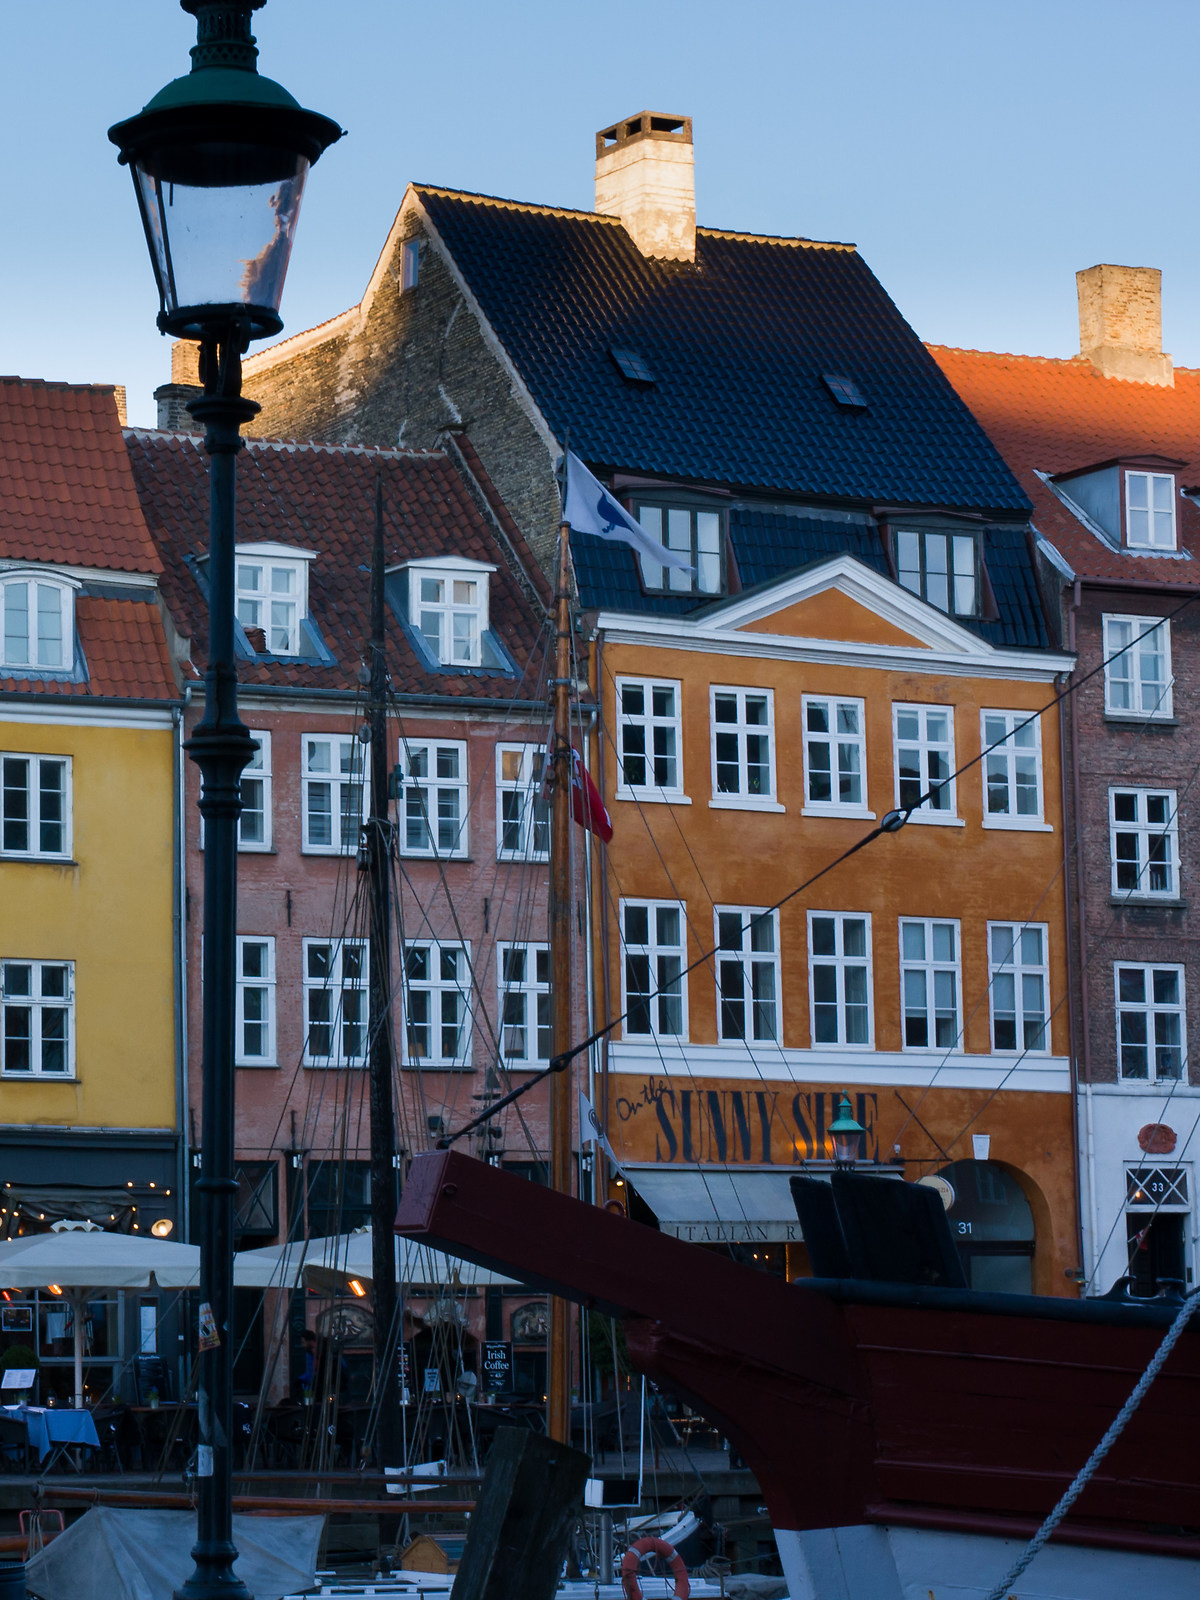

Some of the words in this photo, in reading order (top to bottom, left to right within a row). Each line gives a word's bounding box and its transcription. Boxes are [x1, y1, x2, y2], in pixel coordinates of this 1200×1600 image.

[616, 1098, 643, 1121] On
[640, 1075, 668, 1104] the
[656, 1090, 779, 1164] SUNNY
[1152, 1182, 1164, 1192] 33
[675, 1225, 768, 1241] ITALIAN
[958, 1222, 972, 1234] 31
[487, 1350, 506, 1360] Irish
[484, 1360, 510, 1370] Coffee
